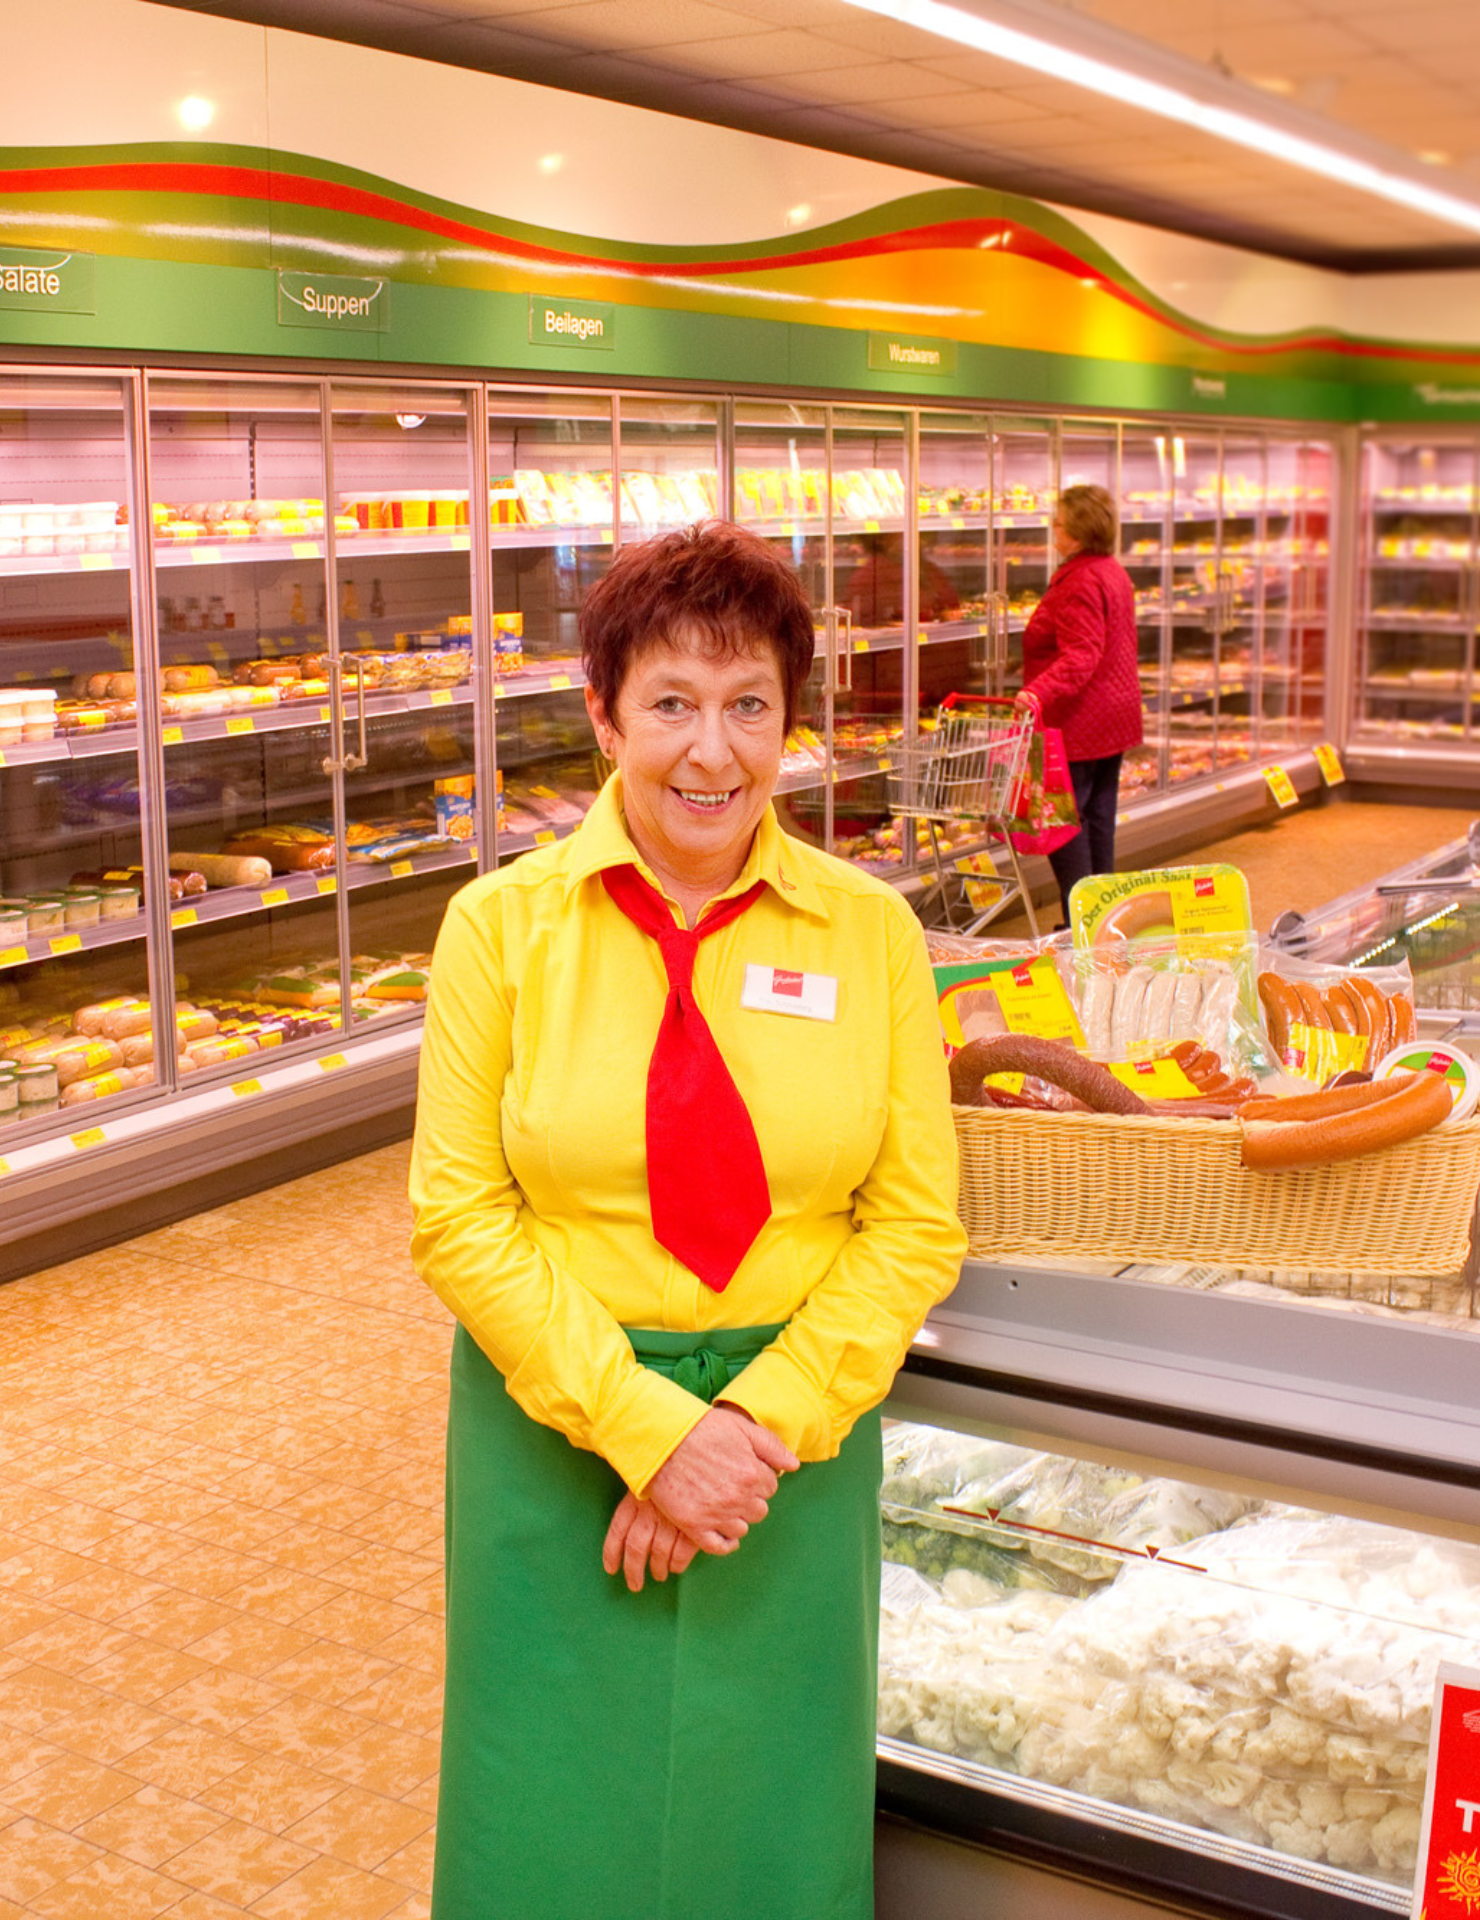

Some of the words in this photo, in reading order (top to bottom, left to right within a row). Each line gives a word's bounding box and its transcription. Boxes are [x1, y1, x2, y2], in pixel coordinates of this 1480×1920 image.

[0, 265, 60, 295] alate
[302, 286, 369, 320] Suppen
[545, 310, 604, 340] Beilagen
[889, 343, 940, 365] Wurstwaren
[1080, 902, 1102, 929] Der
[1100, 872, 1156, 905] Original
